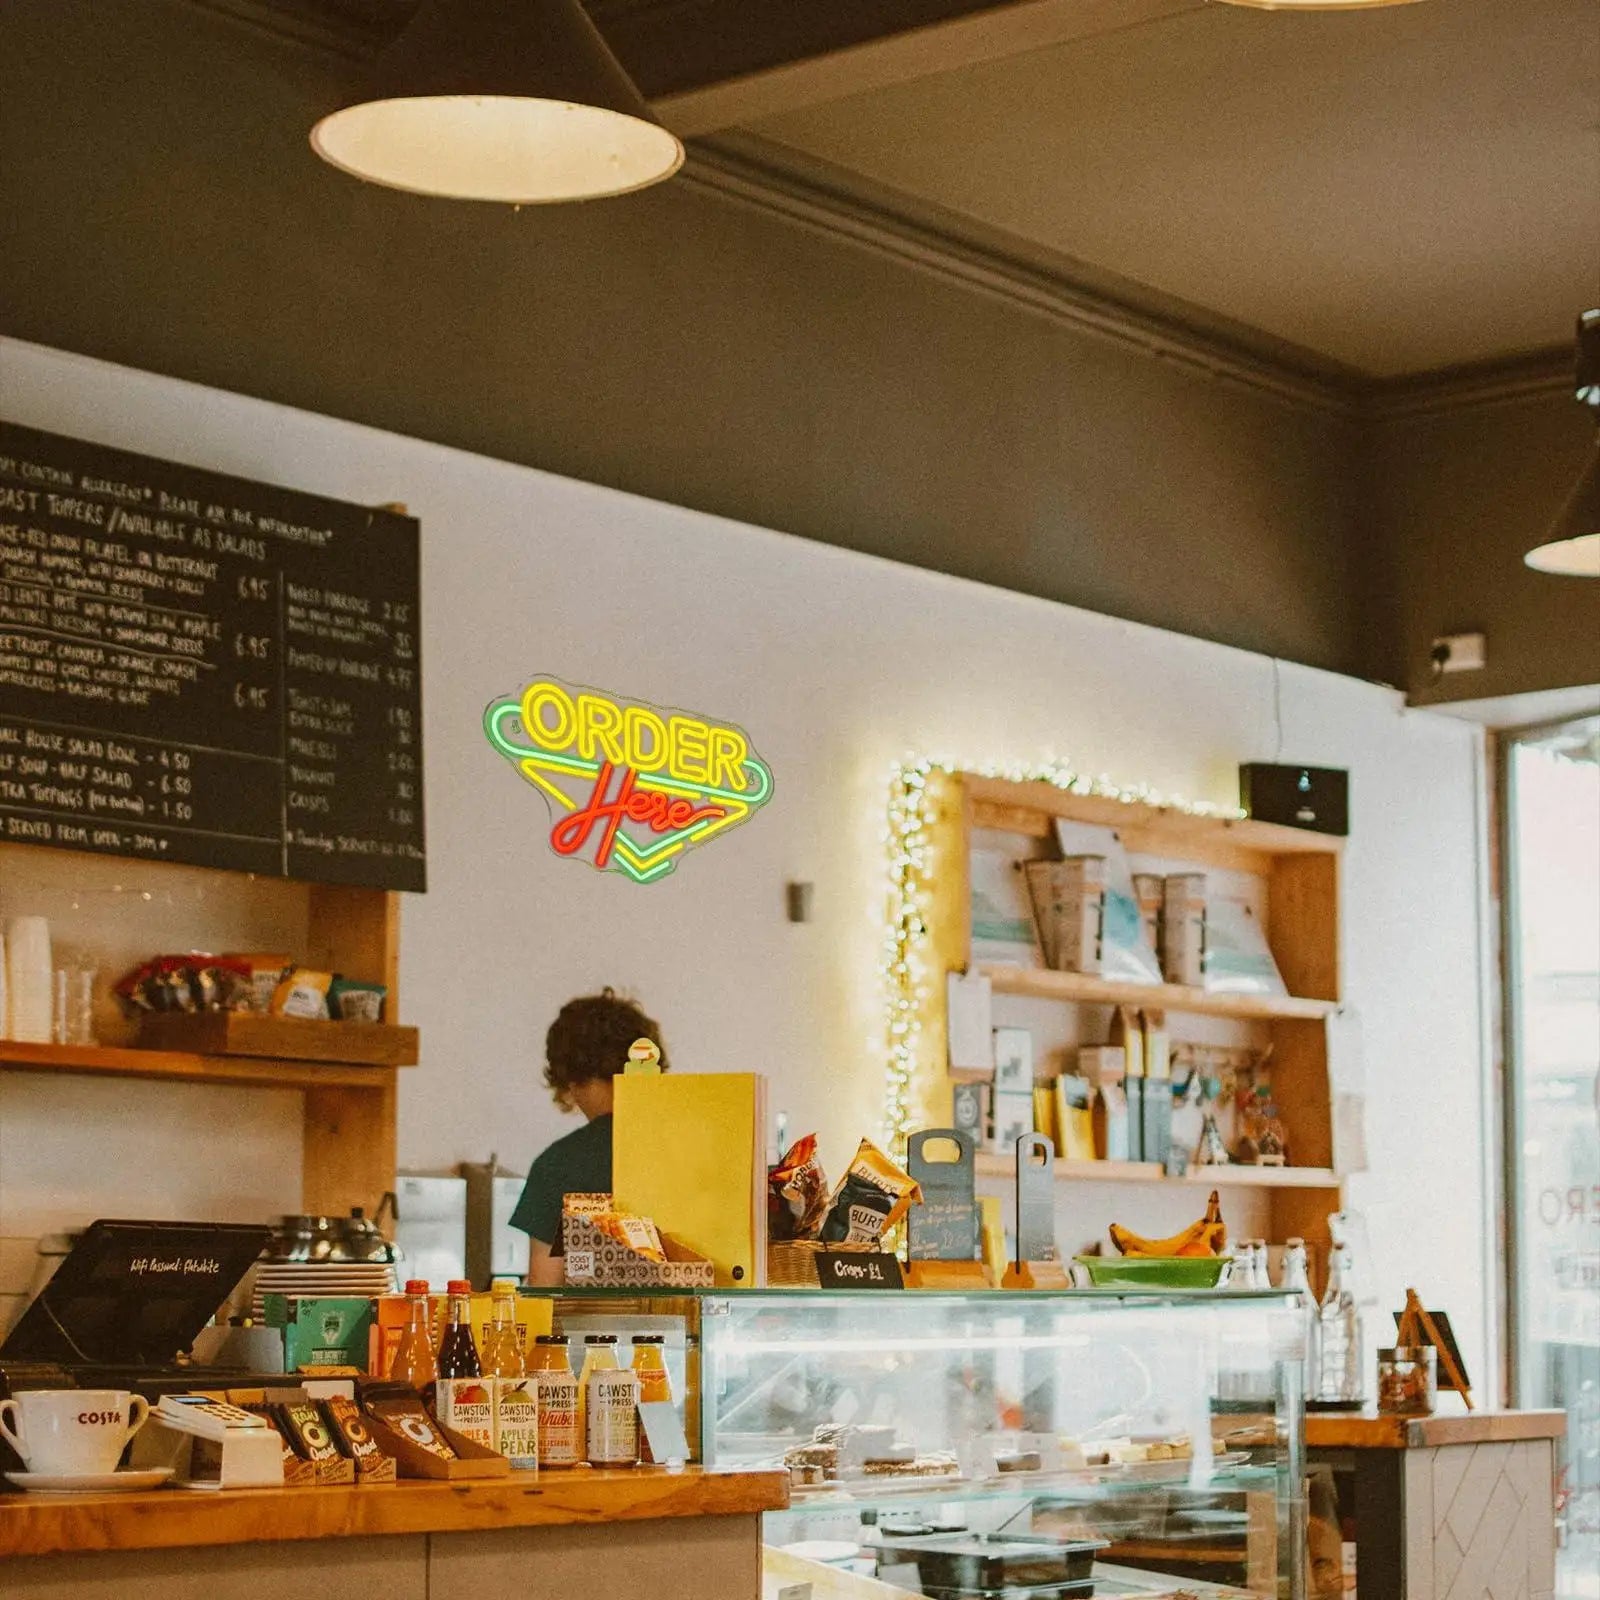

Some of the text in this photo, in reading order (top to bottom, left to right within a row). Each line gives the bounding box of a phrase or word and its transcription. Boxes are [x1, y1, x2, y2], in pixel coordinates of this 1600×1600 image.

[192, 526, 211, 547] AS
[521, 682, 747, 791] ORDER
[551, 761, 726, 868] Here
[8, 818, 51, 838] SERVED
[599, 1384, 635, 1398] CAWST
[611, 1398, 632, 1407] PRESS
[453, 1405, 491, 1417] CAWSTON
[499, 1405, 536, 1416] CAWSTON
[78, 1411, 121, 1425] COSTA
[463, 1416, 480, 1424] PRESS
[509, 1416, 526, 1424] PRESS
[482, 1429, 490, 1441] &
[501, 1429, 535, 1441] APPLE &
[500, 1441, 536, 1456] PEAR
